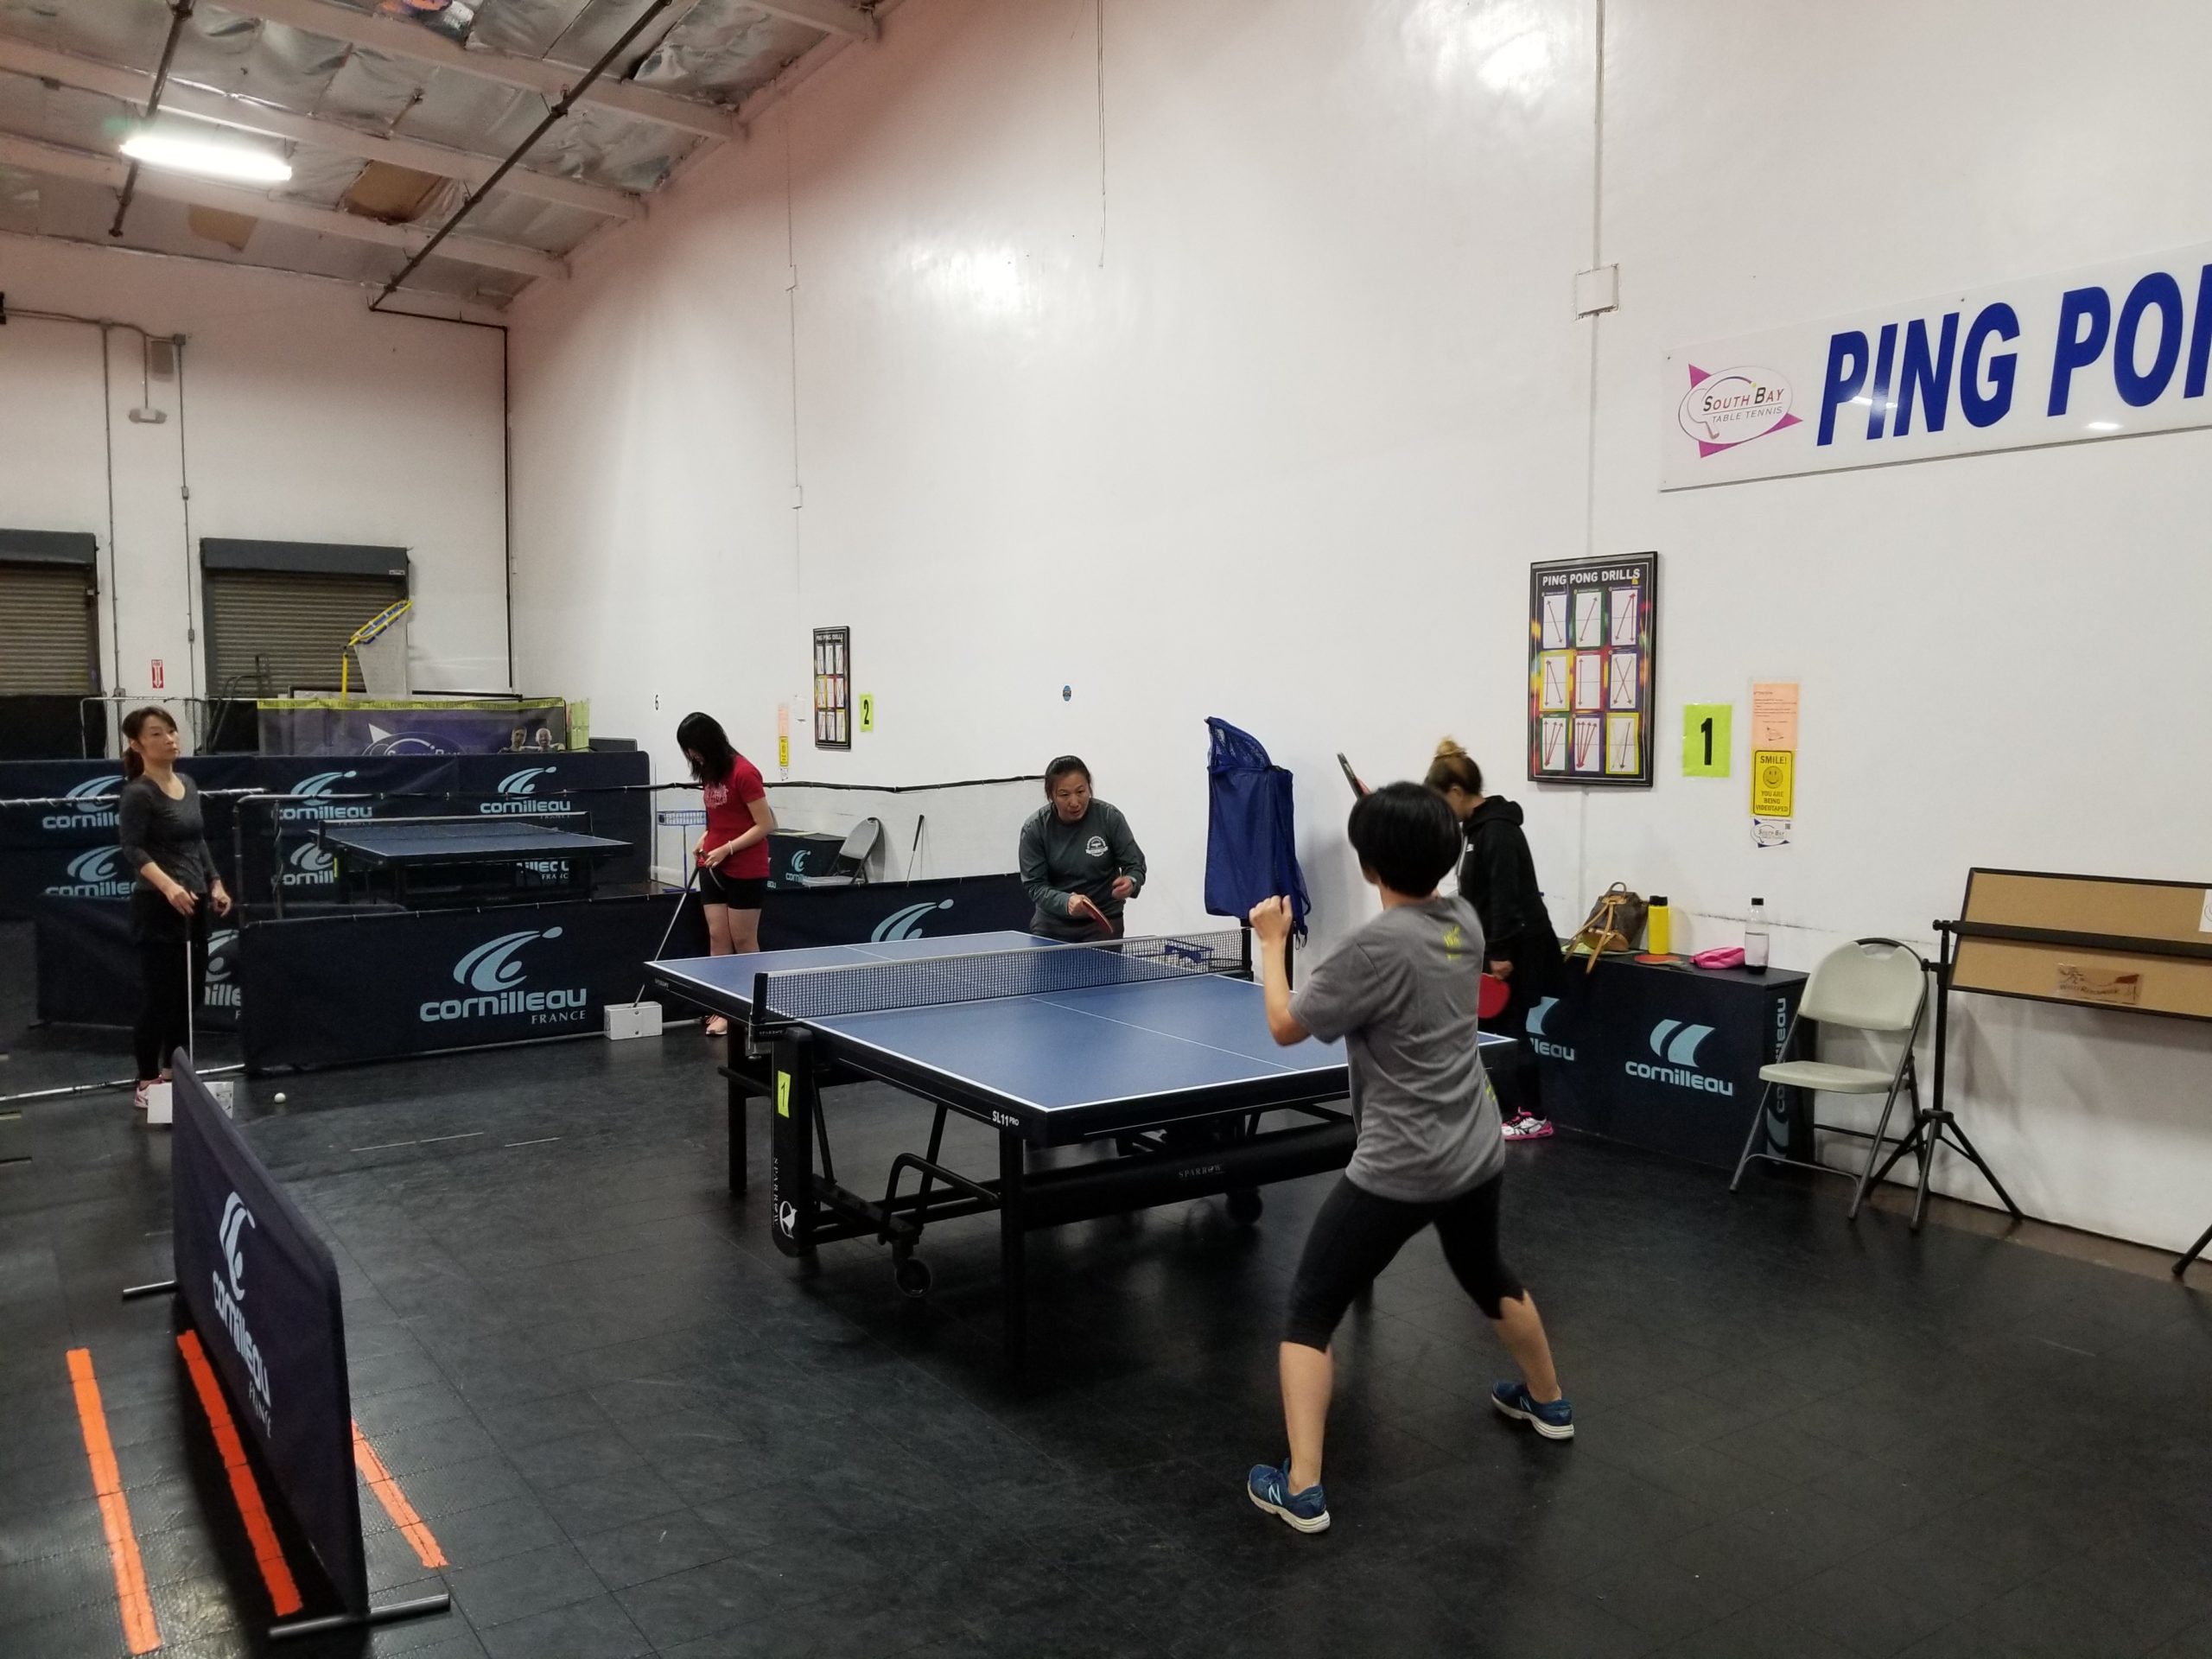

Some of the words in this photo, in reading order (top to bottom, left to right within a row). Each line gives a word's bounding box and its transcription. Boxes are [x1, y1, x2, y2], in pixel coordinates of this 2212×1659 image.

[1816, 302, 2021, 447] PING
[1702, 395, 1751, 412] SOUTH
[1754, 386, 1784, 404] BAY
[1713, 414, 1741, 423] TABLE
[1746, 406, 1783, 419] TENNIS
[1542, 575, 1567, 587] PING
[1569, 571, 1599, 584] PONG
[1601, 569, 1641, 582] DRILLS
[655, 694, 659, 710] 6
[863, 699, 869, 725] 2
[1700, 717, 1713, 766] 1
[1759, 755, 1787, 765] SMILE!
[480, 799, 571, 813] cornilleau
[42, 811, 120, 830] cornill
[45, 880, 137, 897] cornille
[419, 988, 587, 1022] cornilleau
[531, 1010, 587, 1025] FRANCE
[1625, 1060, 1733, 1096] cornilleau
[780, 1081, 785, 1107] 1
[213, 1269, 272, 1408] cornilleau
